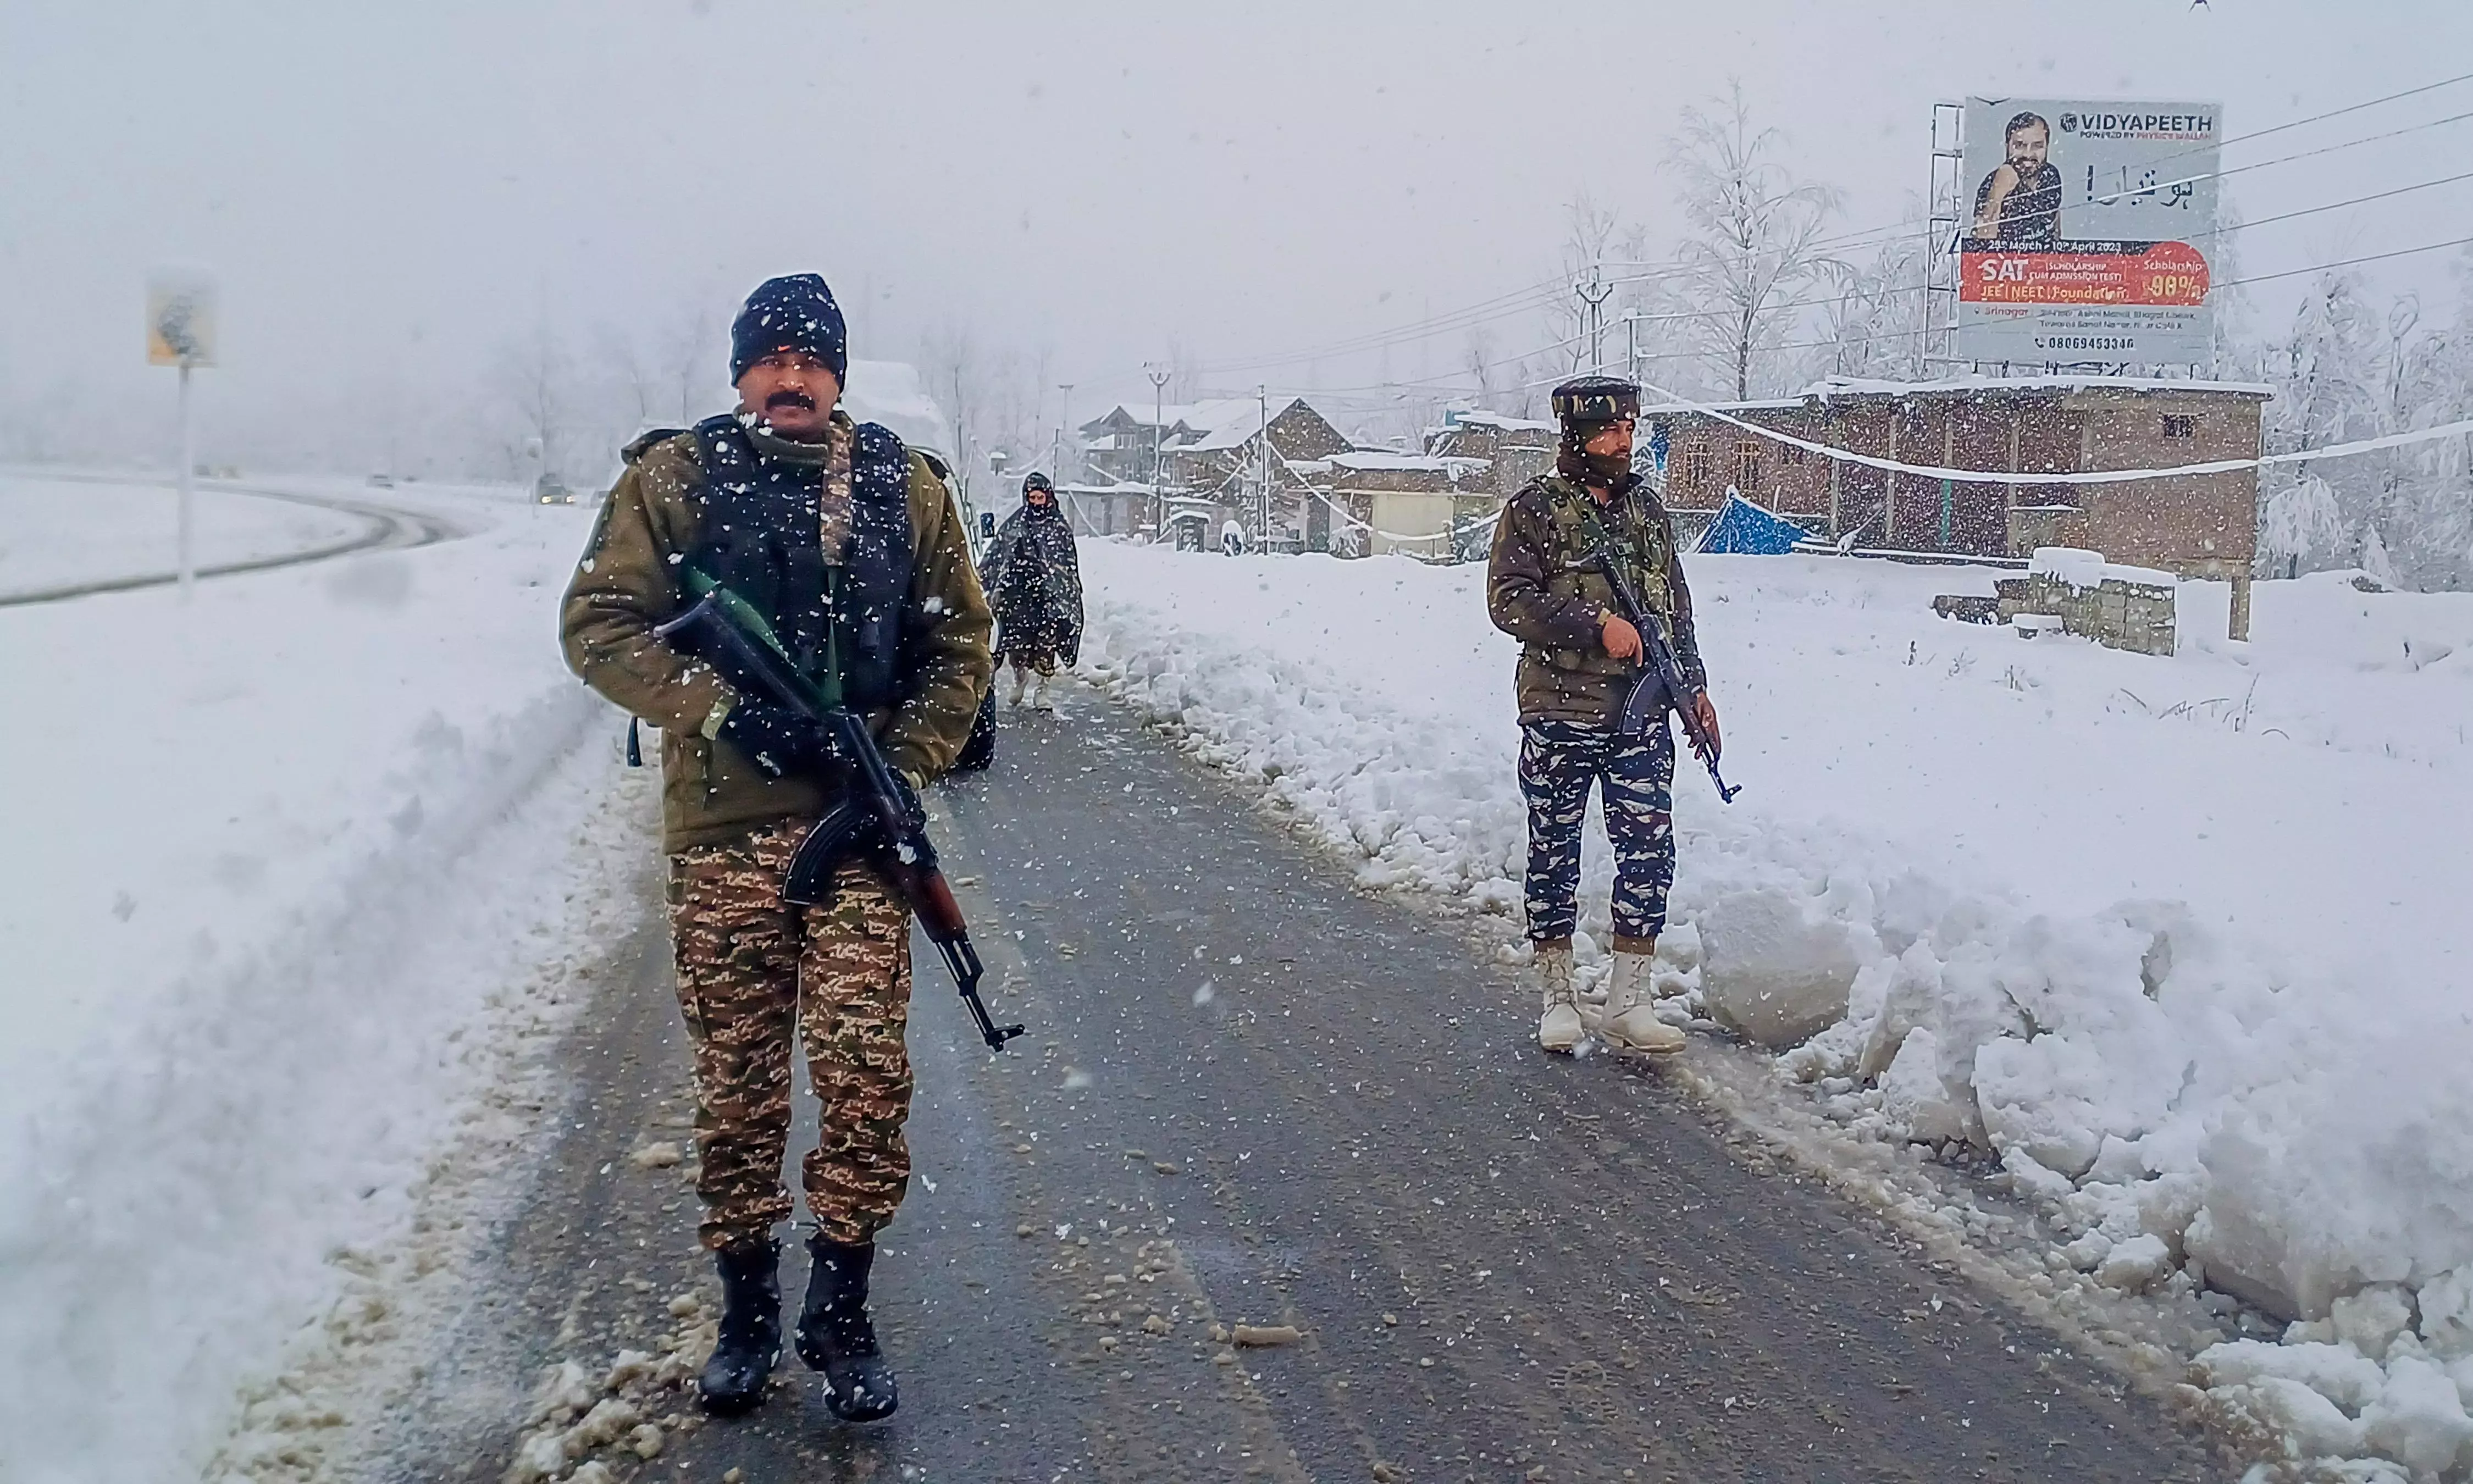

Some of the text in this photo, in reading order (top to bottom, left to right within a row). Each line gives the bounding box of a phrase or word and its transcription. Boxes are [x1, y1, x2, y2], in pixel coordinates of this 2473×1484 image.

[2081, 114, 2212, 131] VIDYAPEETH
[2071, 241, 2095, 253] April
[1980, 259, 2029, 281] SAT
[2143, 260, 2203, 273] Scholarship
[1980, 285, 2002, 297] JEE
[2011, 286, 2045, 298] NEET
[1984, 307, 2029, 319] Srinagar
